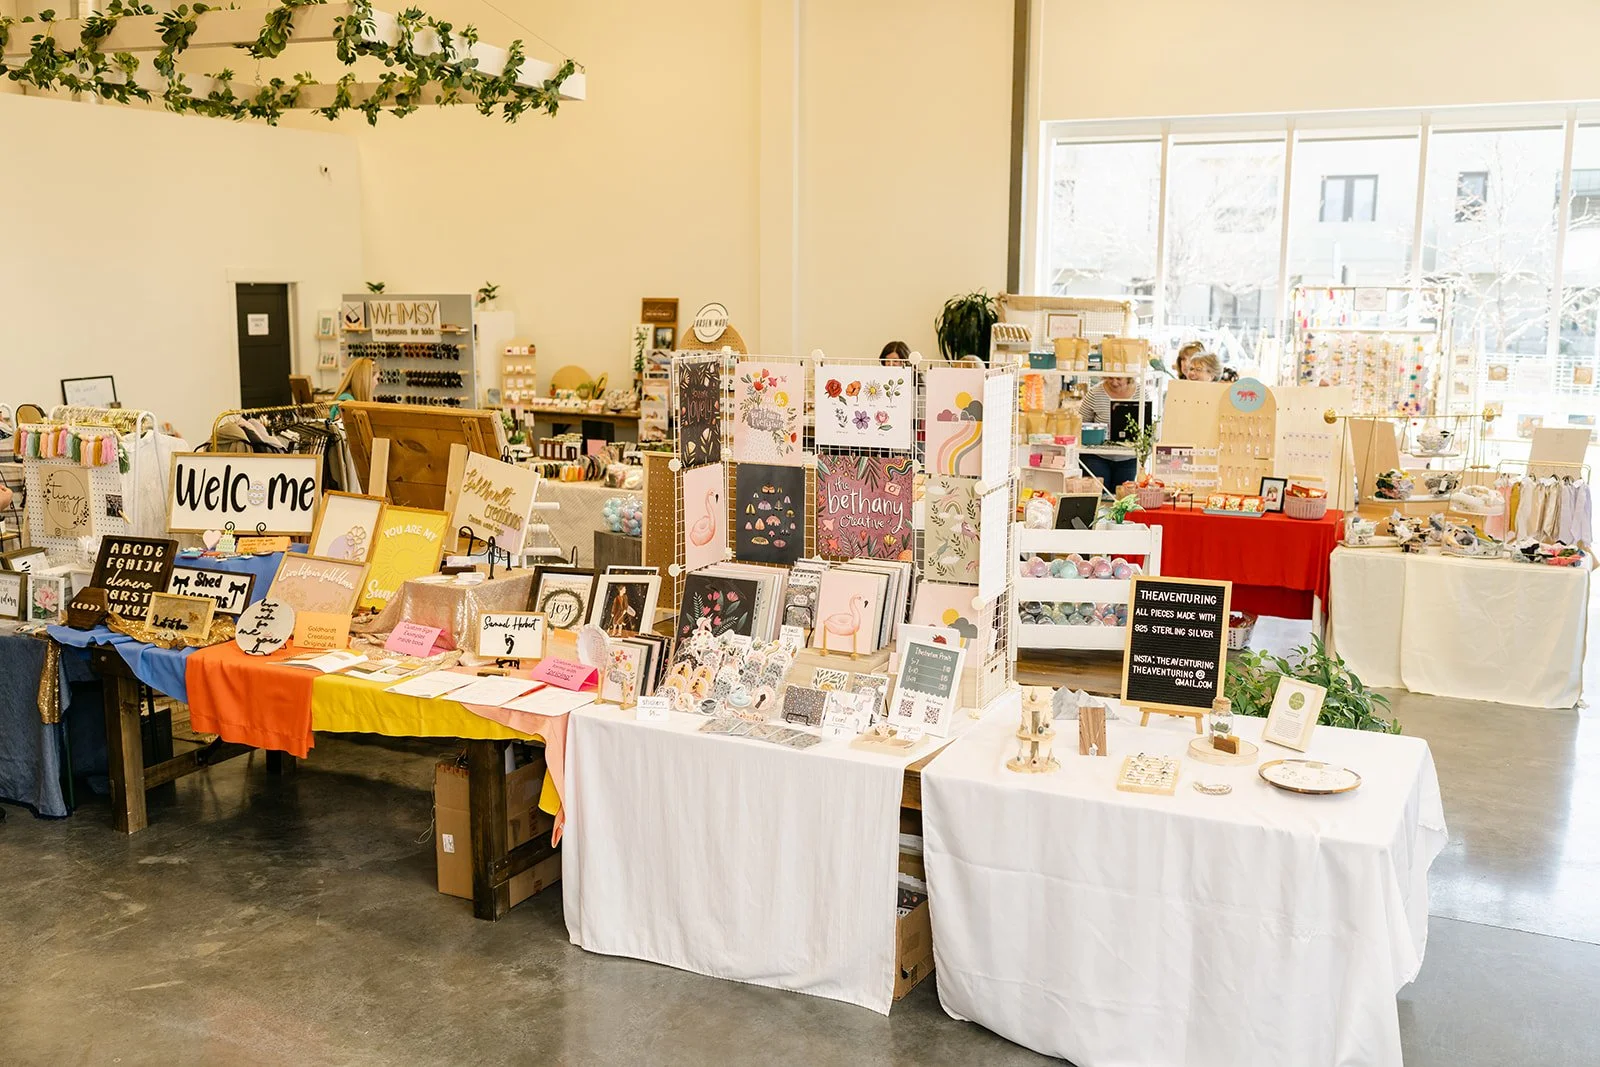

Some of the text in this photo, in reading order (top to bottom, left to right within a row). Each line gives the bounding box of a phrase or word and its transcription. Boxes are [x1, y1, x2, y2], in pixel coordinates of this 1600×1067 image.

[370, 302, 438, 325] WHIMSY
[375, 327, 434, 337] sunglasses for kids
[834, 477, 849, 491] the
[49, 482, 85, 516] tiny
[827, 483, 903, 534] bethany
[384, 525, 437, 542] YOU ARE MY
[195, 572, 223, 588] Shed
[1140, 590, 1217, 605] THEAVENTURING
[1135, 608, 1216, 622] ALL PIECES MADE WITH
[308, 625, 337, 633] Goldhardt
[484, 616, 540, 631] Samuel Herbert
[307, 633, 335, 641] Creations
[1134, 624, 1214, 639] 925 STERLING SILVER
[252, 637, 282, 653] you
[304, 640, 326, 649] Original
[1133, 654, 1215, 670] INSTA: THEAVENTURING
[1132, 665, 1194, 679] THEAVENTURING
[1174, 678, 1213, 689] GMAIL.COM
